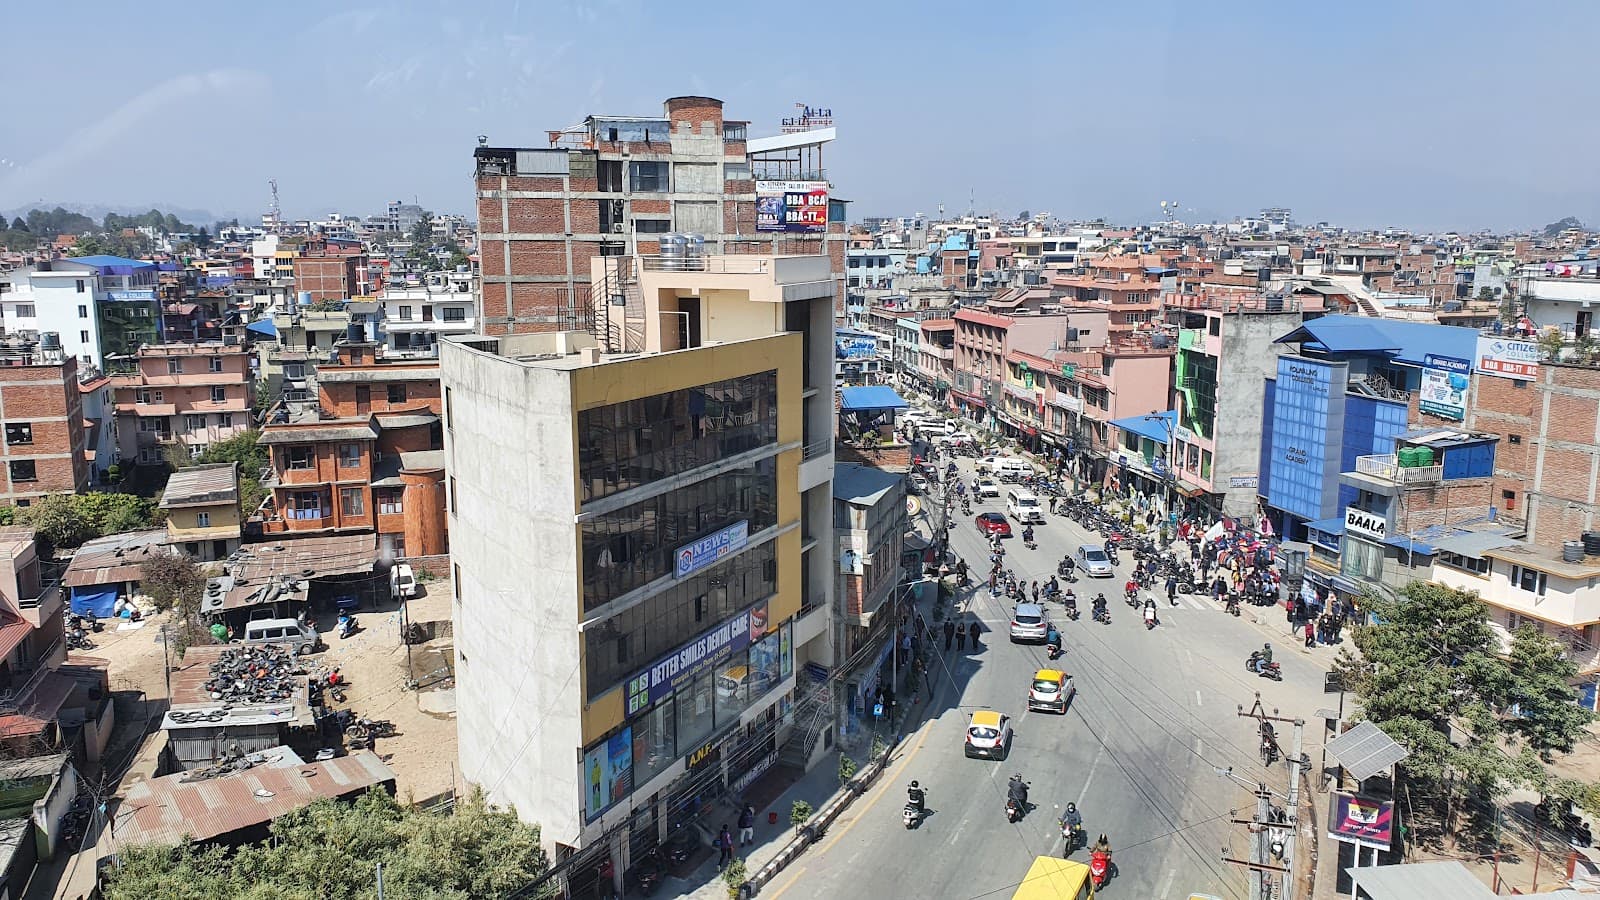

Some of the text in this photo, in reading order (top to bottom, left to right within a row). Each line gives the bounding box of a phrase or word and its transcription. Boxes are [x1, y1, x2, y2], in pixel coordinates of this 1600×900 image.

[786, 195, 826, 205] BBA BCA
[786, 212, 817, 221] BBA-TT
[1507, 342, 1536, 352] CITIZE
[1289, 446, 1306, 456] GRAND
[1286, 454, 1309, 465] ACADEMY
[1348, 513, 1386, 534] BAALA
[692, 530, 729, 557] NEWS
[651, 656, 680, 688] BETTER
[680, 638, 706, 670] SMILES
[706, 625, 731, 653] DENTAL
[732, 614, 748, 638] CARE
